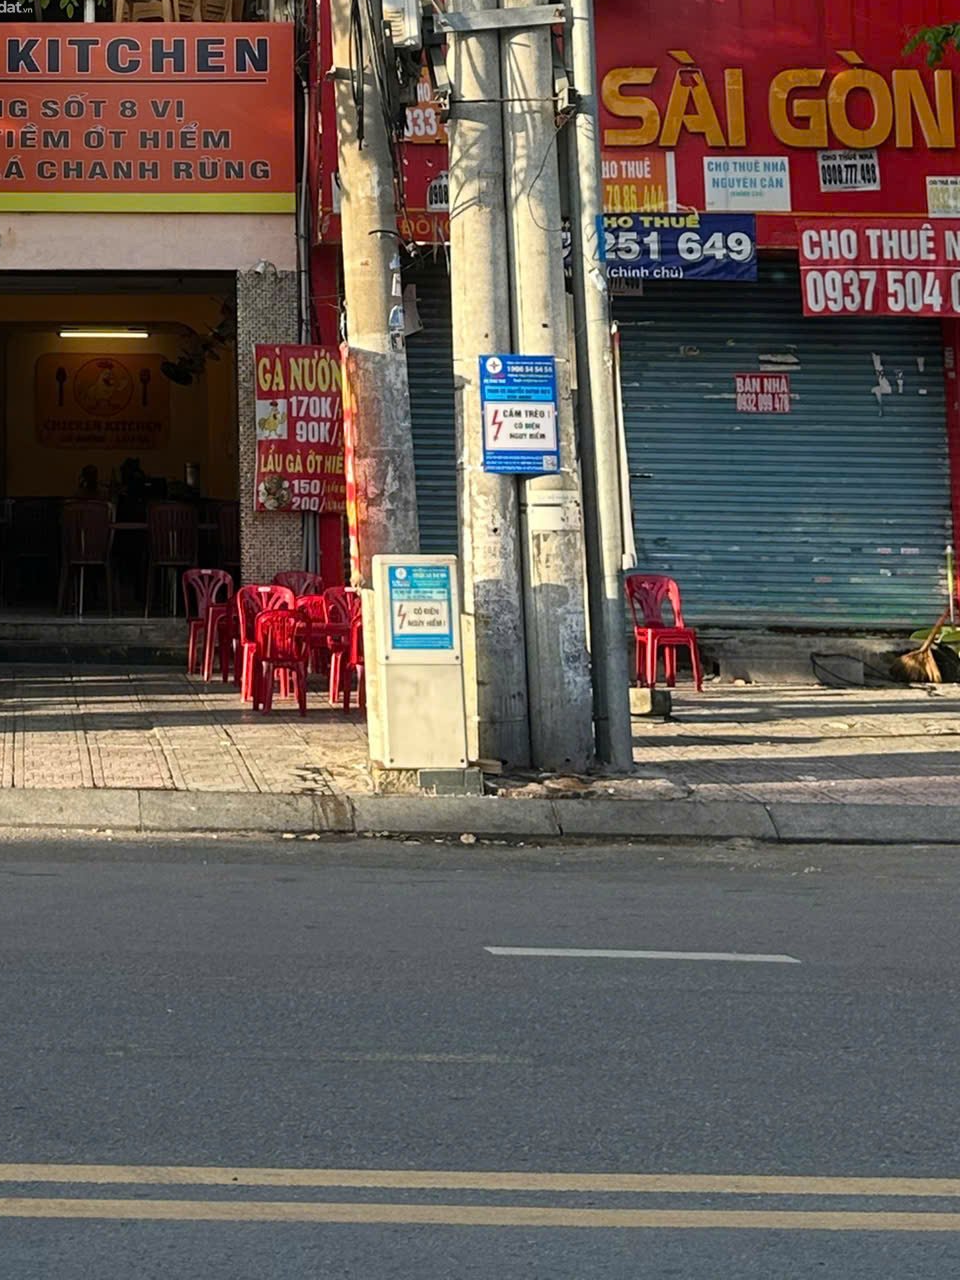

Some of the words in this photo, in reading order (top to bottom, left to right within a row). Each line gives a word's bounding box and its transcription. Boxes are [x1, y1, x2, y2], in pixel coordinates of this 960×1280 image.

[6, 37, 269, 74] KITCHEN
[40, 92, 107, 119] SỐT
[119, 99, 138, 119] 8
[151, 99, 186, 122] VỊ
[601, 50, 747, 148] SÀI
[768, 50, 956, 149] GÒN
[38, 160, 159, 180] CHANH
[173, 155, 271, 181] RỪNG
[602, 160, 618, 179] HO
[620, 157, 651, 179] THUÊ
[707, 160, 730, 173] CHO
[603, 216, 633, 229] HO
[641, 214, 700, 229] THUÊ
[677, 231, 754, 262] 649
[802, 228, 858, 261] CHO
[865, 223, 937, 261] THUÊ
[805, 270, 877, 313] 0937
[887, 270, 943, 313] 504
[257, 347, 286, 392] GÀ
[289, 349, 342, 393] NƯỚN
